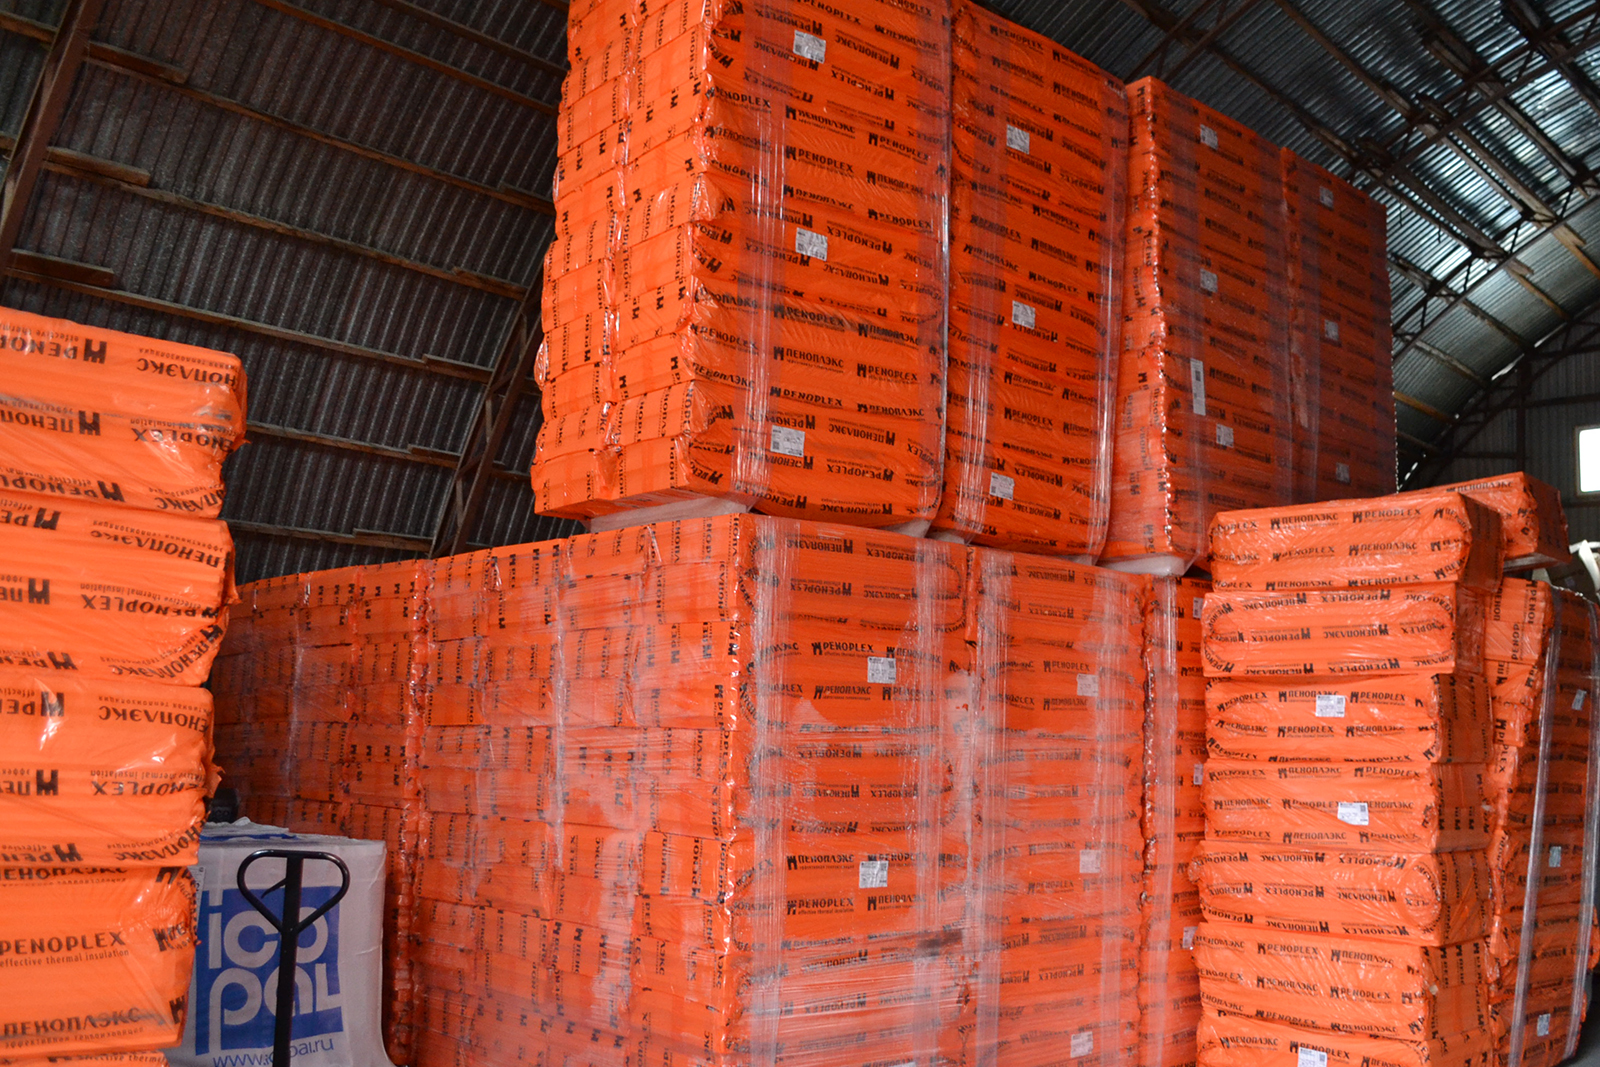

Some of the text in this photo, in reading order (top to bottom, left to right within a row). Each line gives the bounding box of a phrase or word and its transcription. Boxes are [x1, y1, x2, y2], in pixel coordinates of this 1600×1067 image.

[835, 34, 890, 67] ПЕНОПЛЭКС
[879, 136, 930, 162] PENOPLEX
[798, 148, 854, 174] PENOPLEX
[826, 226, 883, 251] PENOPLEX
[786, 348, 844, 368] ПЕНОПЛЭКС
[867, 365, 918, 381] PENOPLEX
[829, 422, 886, 445] ПЕНОПЛЭКС
[1281, 512, 1339, 525] ПЕНОПЛЭКС
[1364, 508, 1422, 519] PENOPLEX
[90, 530, 220, 568] ПЕНОПЛЭКС
[1360, 541, 1418, 551] ПЕНОПЛЭКС
[80, 582, 126, 596] insulation
[82, 594, 197, 618] PENOPLEX
[1323, 628, 1379, 639] ПЕНОПЛЭКС
[823, 641, 876, 654] PENOPLEX
[1328, 662, 1389, 675] PENOPLEX
[1360, 691, 1407, 702] PENOPLEX
[1287, 726, 1335, 734] PENOPLEX
[1364, 767, 1421, 779] PENOPLEX
[798, 854, 855, 864] ПЕНОПЛЭКС
[798, 898, 855, 909] PENOPLEX
[0, 930, 126, 956] PENOPLEX
[46, 954, 84, 966] thermal
[3, 1007, 141, 1037] ПЕНОПЛЭКС
